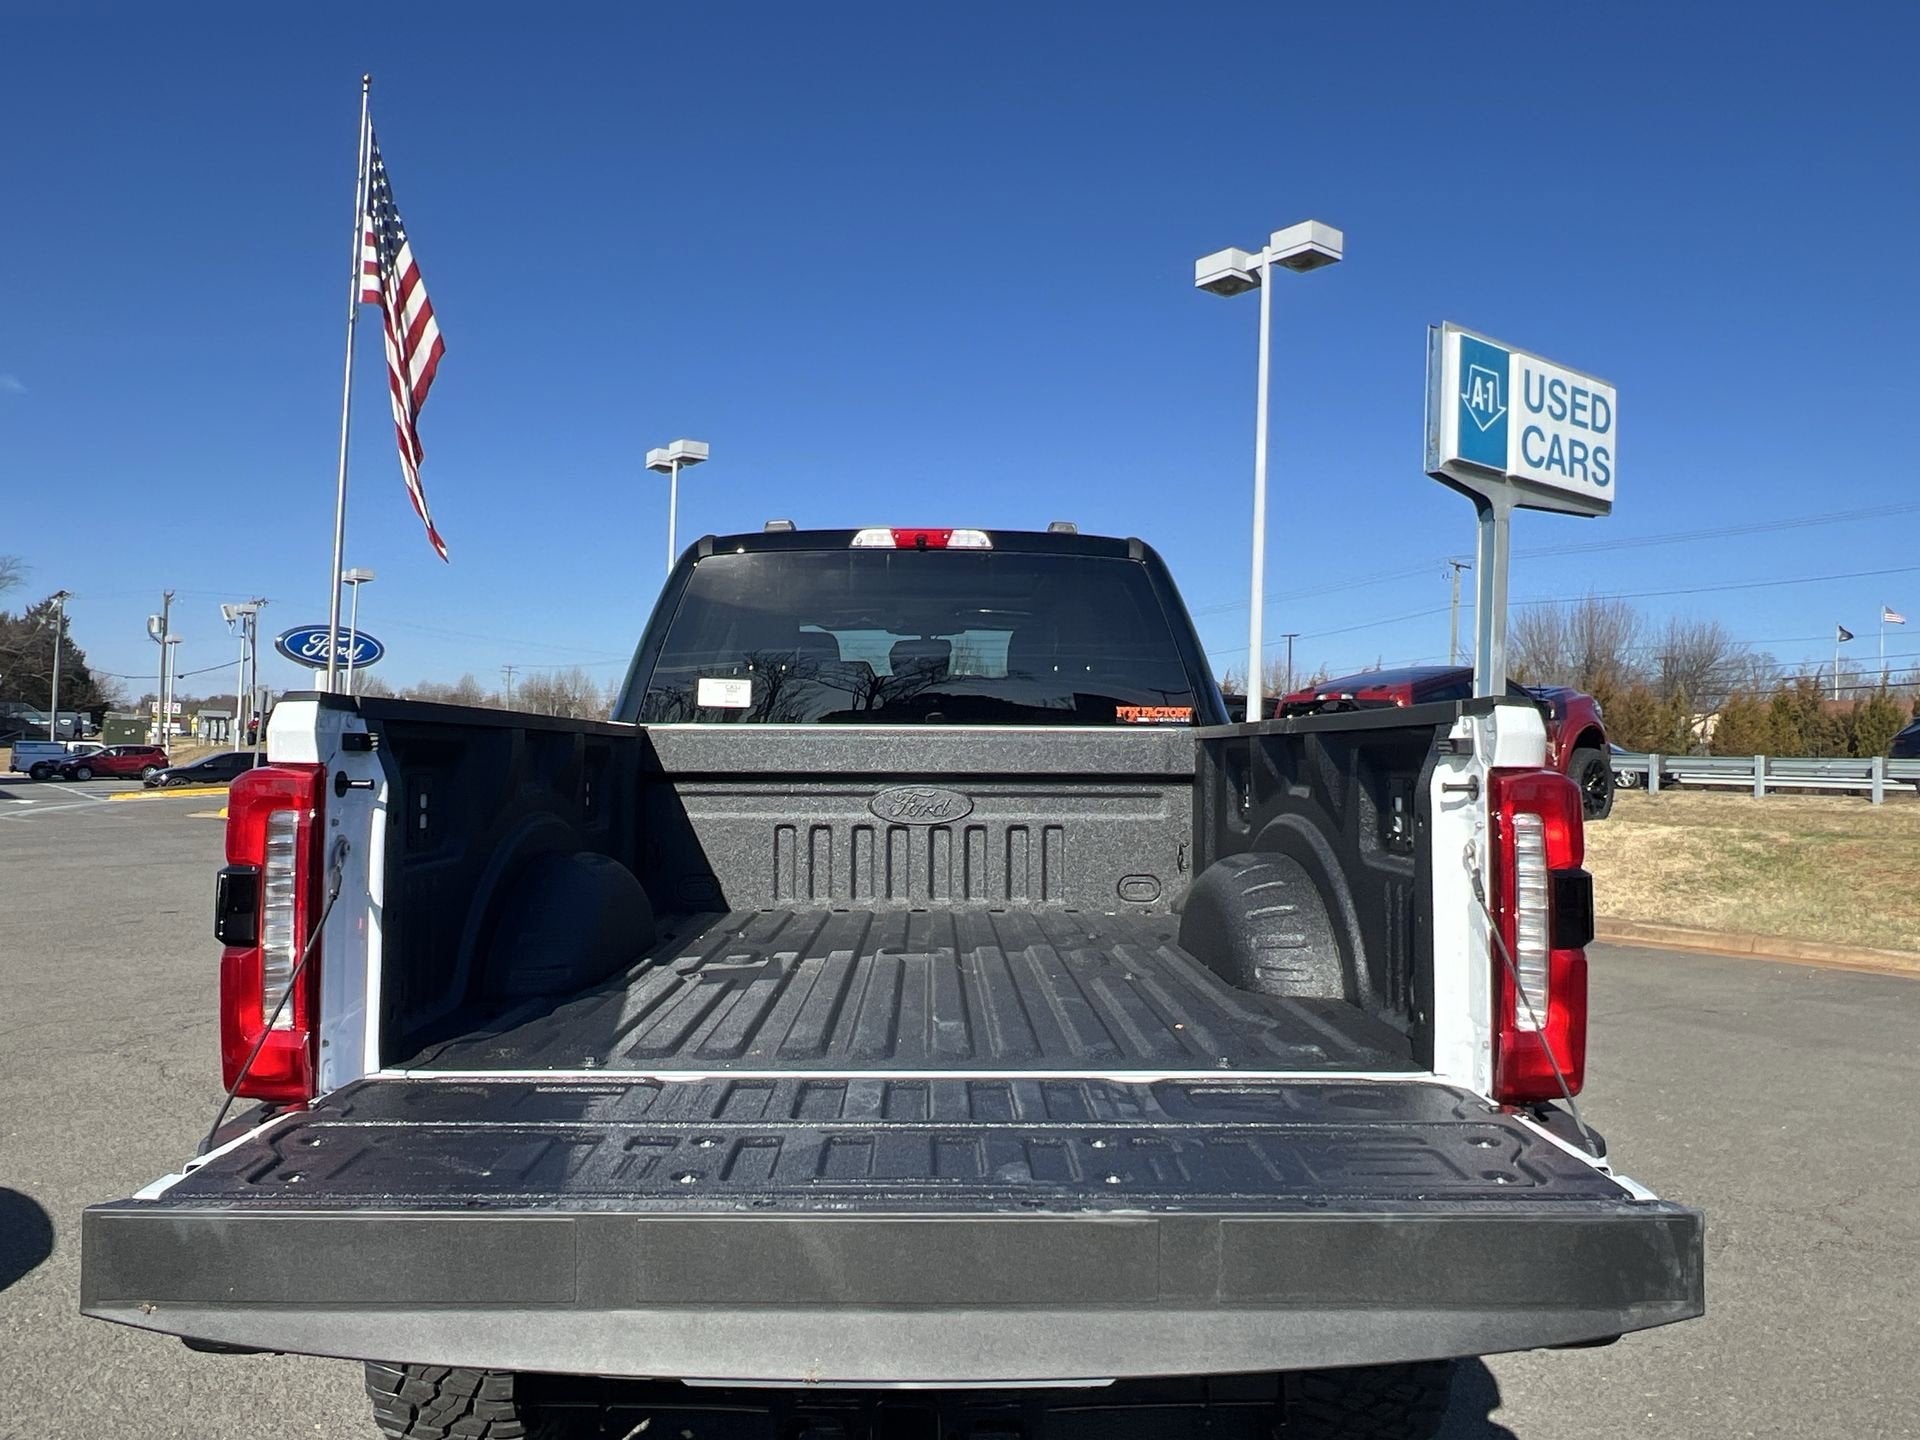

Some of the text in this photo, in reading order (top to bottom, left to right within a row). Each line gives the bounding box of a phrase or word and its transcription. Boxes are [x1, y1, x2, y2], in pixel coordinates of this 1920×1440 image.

[1471, 376, 1494, 414] A-1
[1523, 369, 1612, 434] USED
[1521, 425, 1610, 487] CARS
[1141, 706, 1192, 718] FACTORY
[889, 791, 952, 817] Ford
